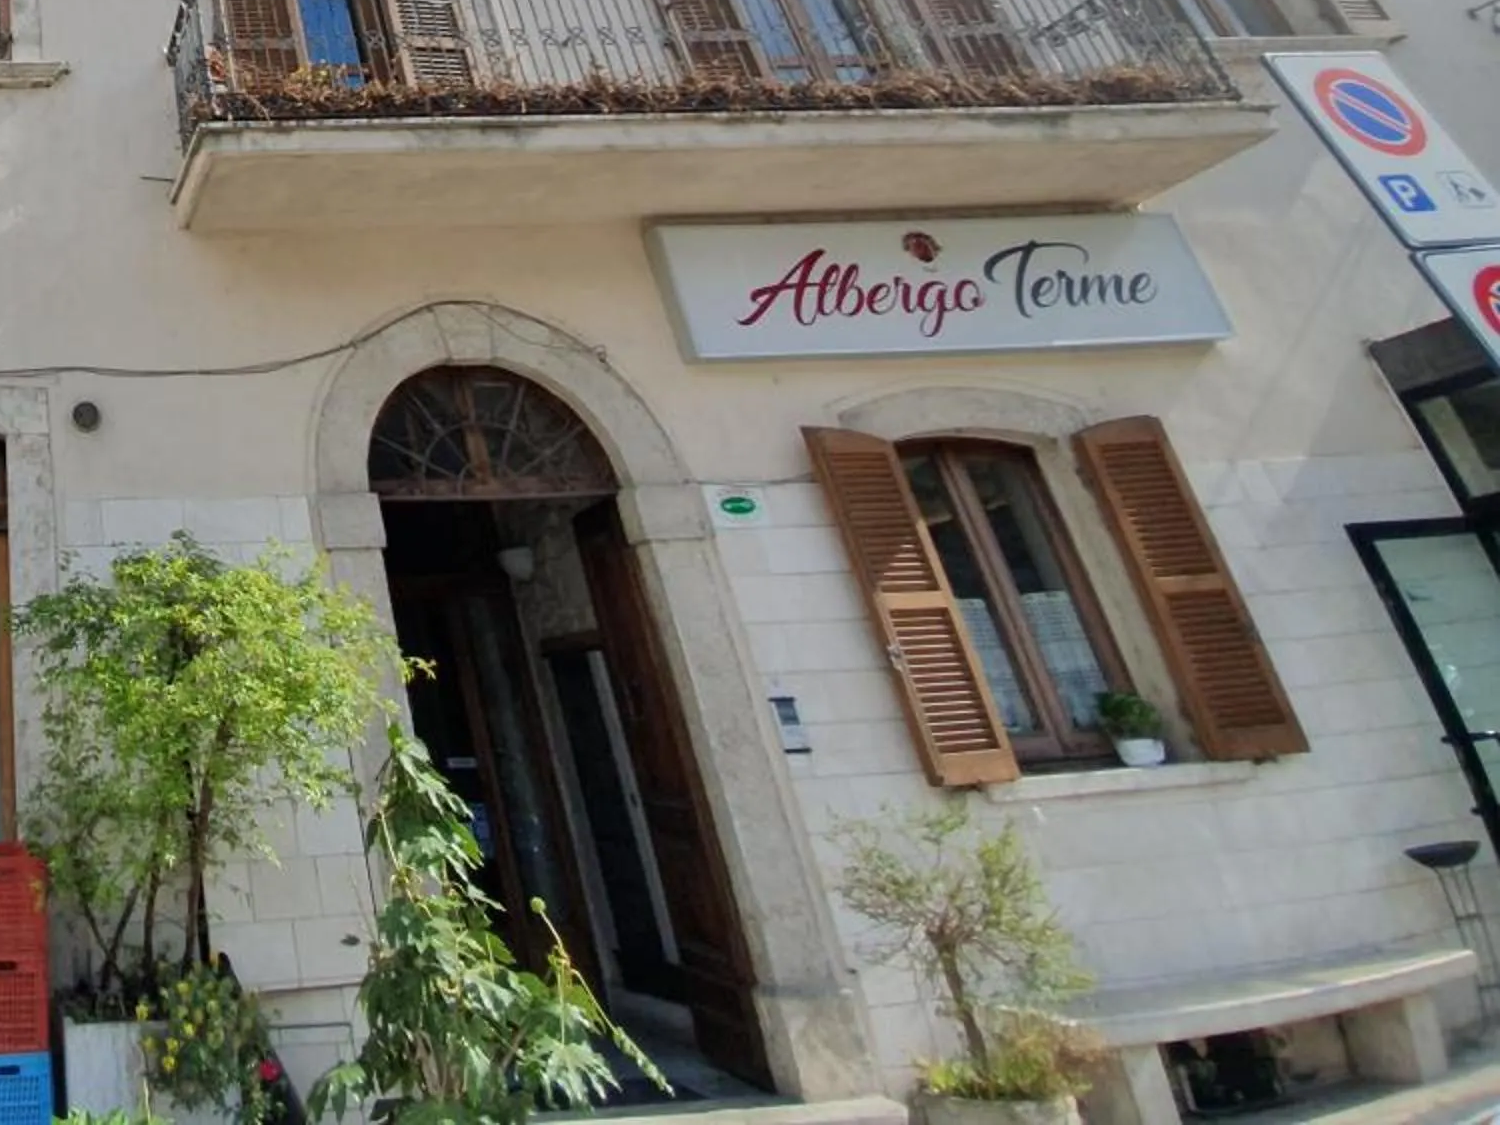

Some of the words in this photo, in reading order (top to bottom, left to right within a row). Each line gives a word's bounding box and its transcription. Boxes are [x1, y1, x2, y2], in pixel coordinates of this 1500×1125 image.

[1387, 179, 1418, 208] P
[737, 247, 984, 338] Albergo
[983, 239, 1158, 319] Terme
